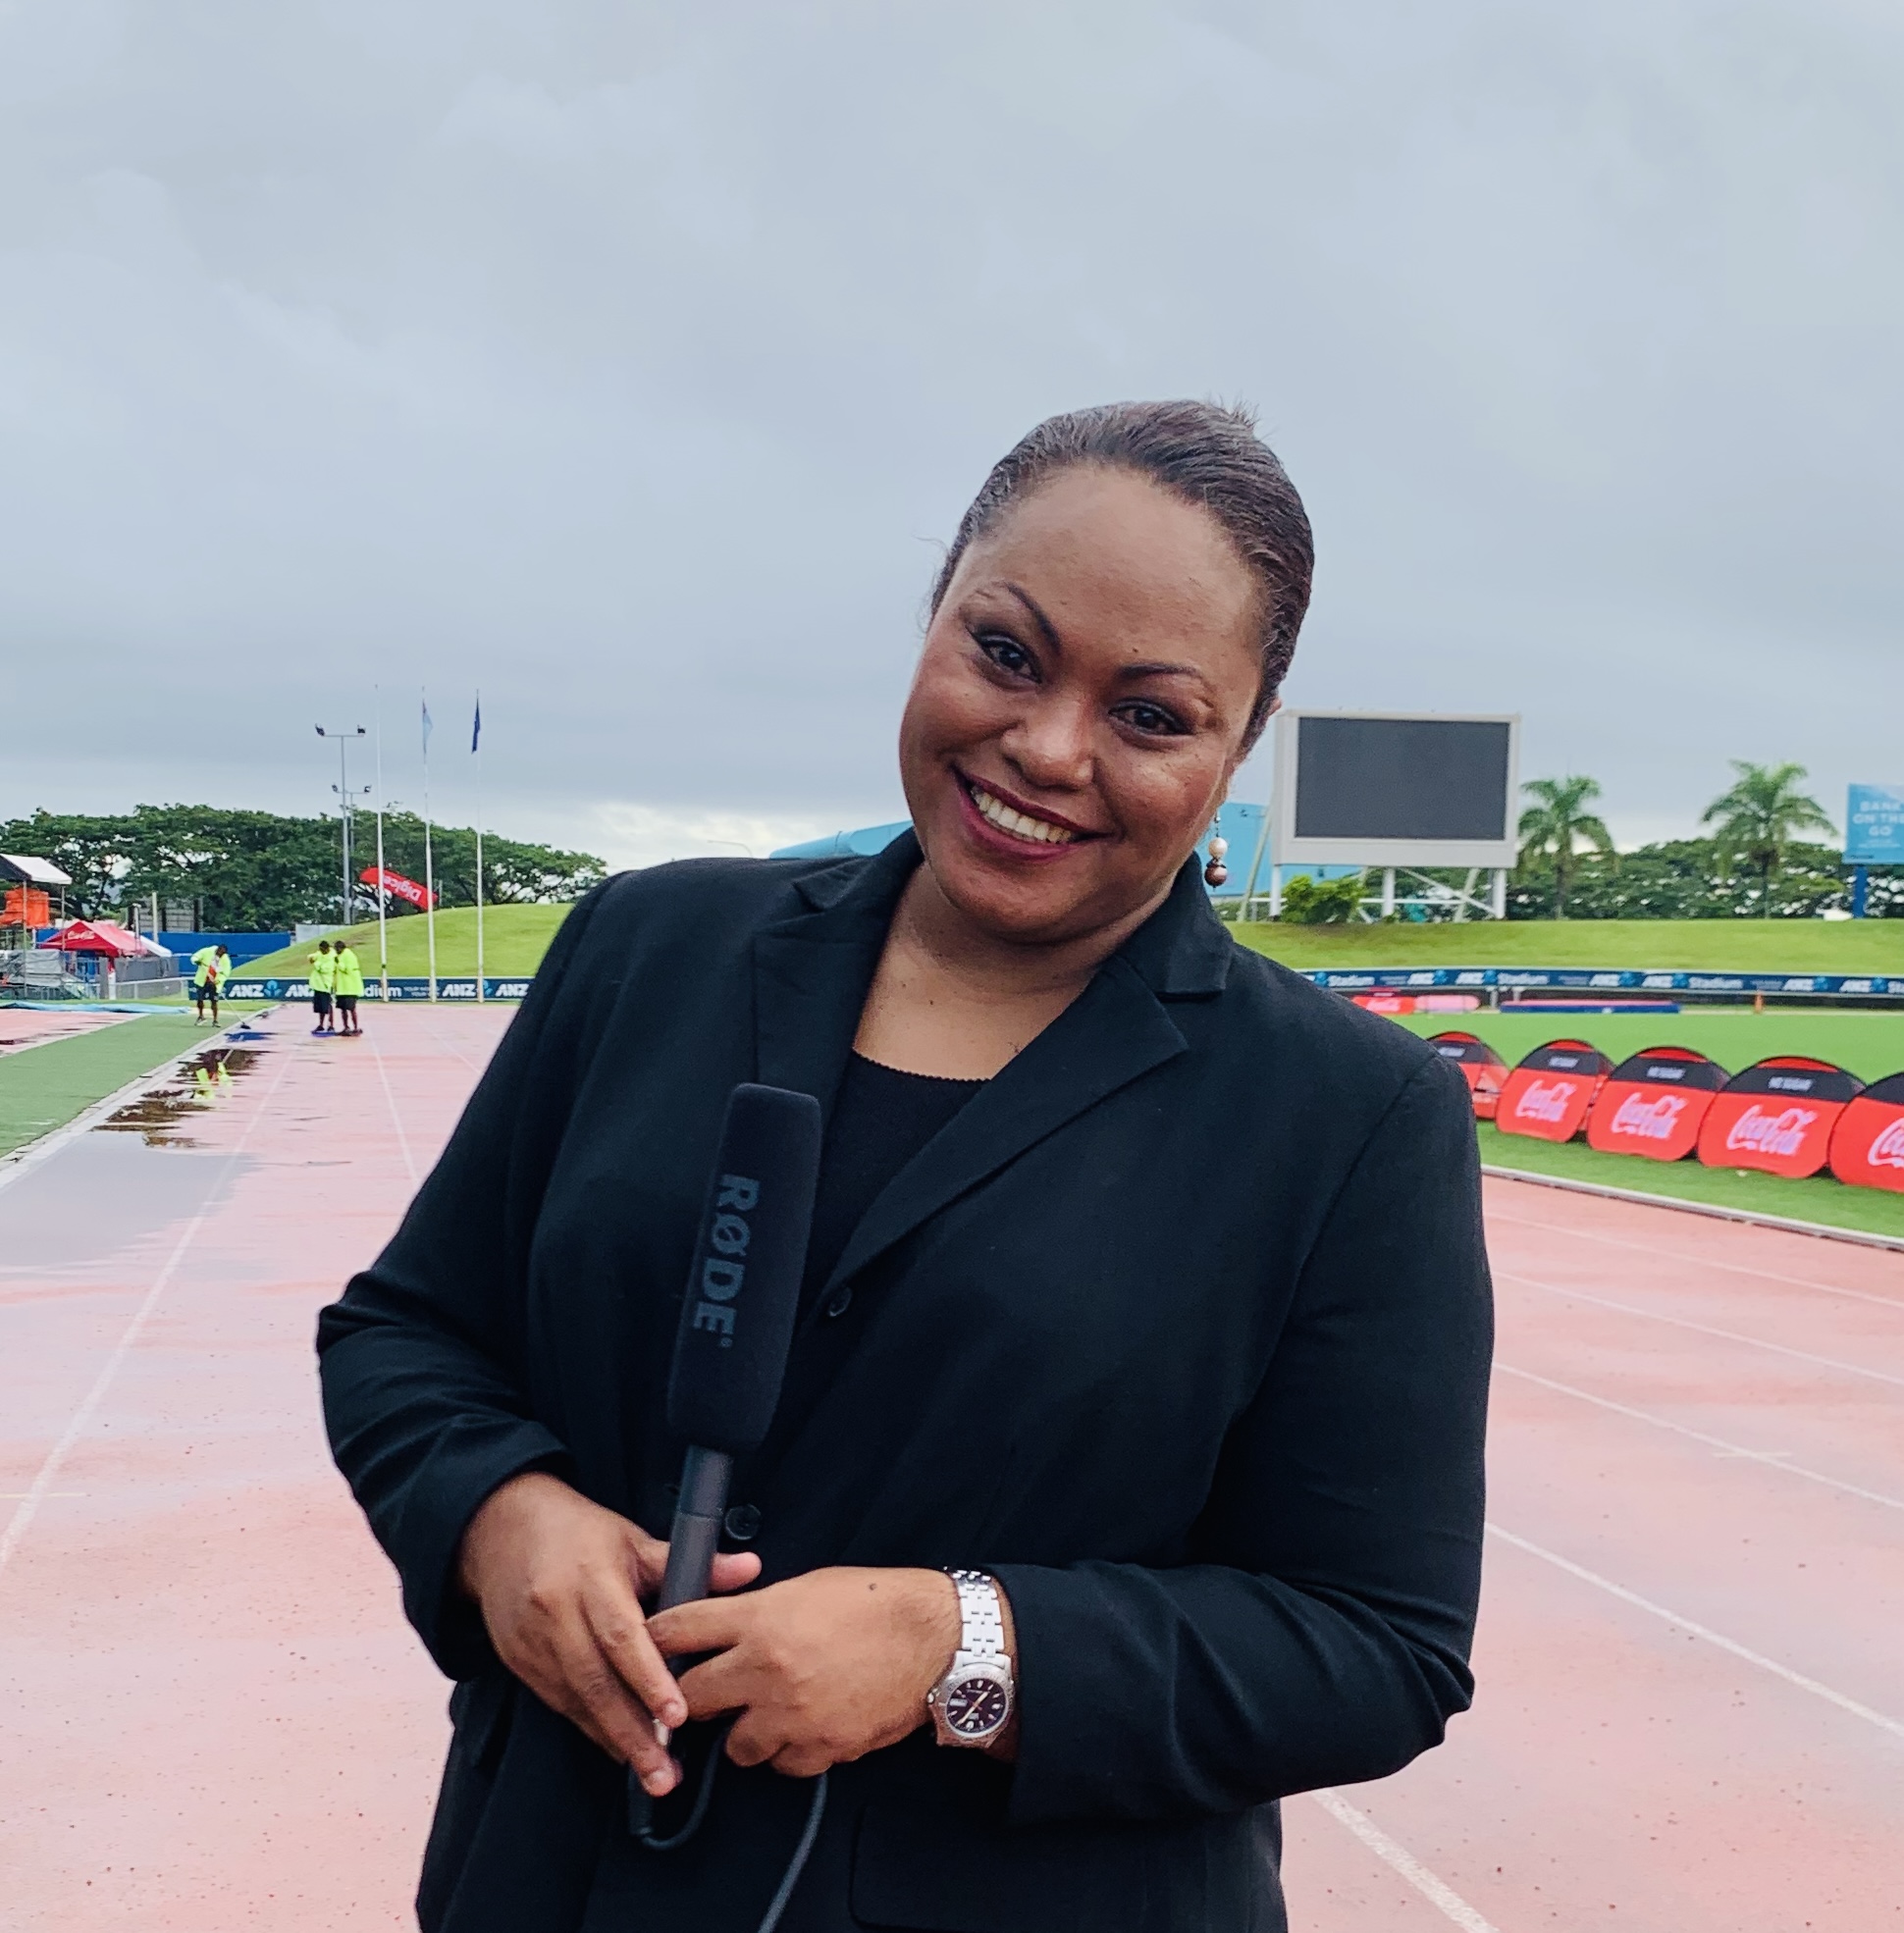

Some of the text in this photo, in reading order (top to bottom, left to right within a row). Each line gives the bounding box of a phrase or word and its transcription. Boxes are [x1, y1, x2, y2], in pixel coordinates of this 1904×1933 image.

[382, 875, 422, 902] Digice
[229, 984, 264, 998] ANZ
[442, 983, 476, 997] ANZ
[495, 983, 530, 997] ANZ
